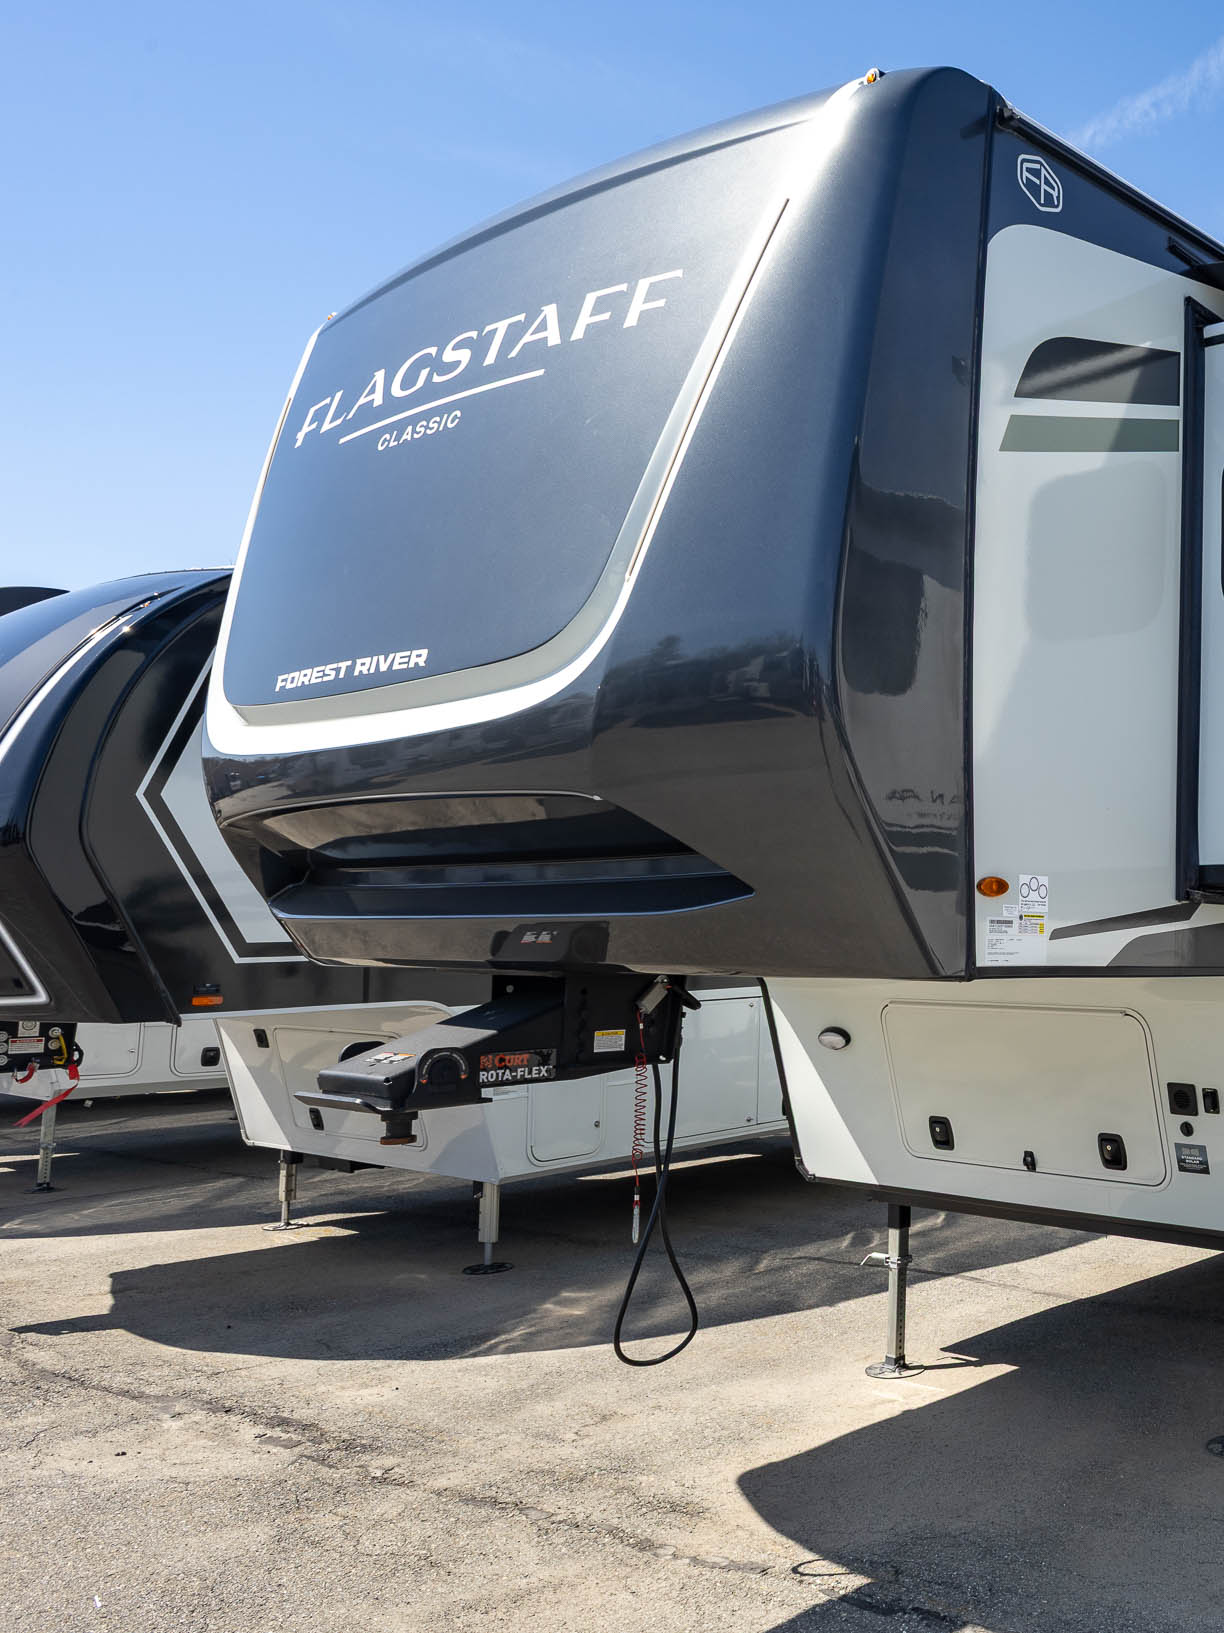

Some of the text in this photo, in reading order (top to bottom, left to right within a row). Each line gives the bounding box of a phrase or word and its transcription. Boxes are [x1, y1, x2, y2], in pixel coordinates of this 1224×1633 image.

[294, 269, 684, 449] FLAGSTAFF
[377, 409, 462, 451] CLASSIC
[274, 648, 429, 692] FOREST RIVER
